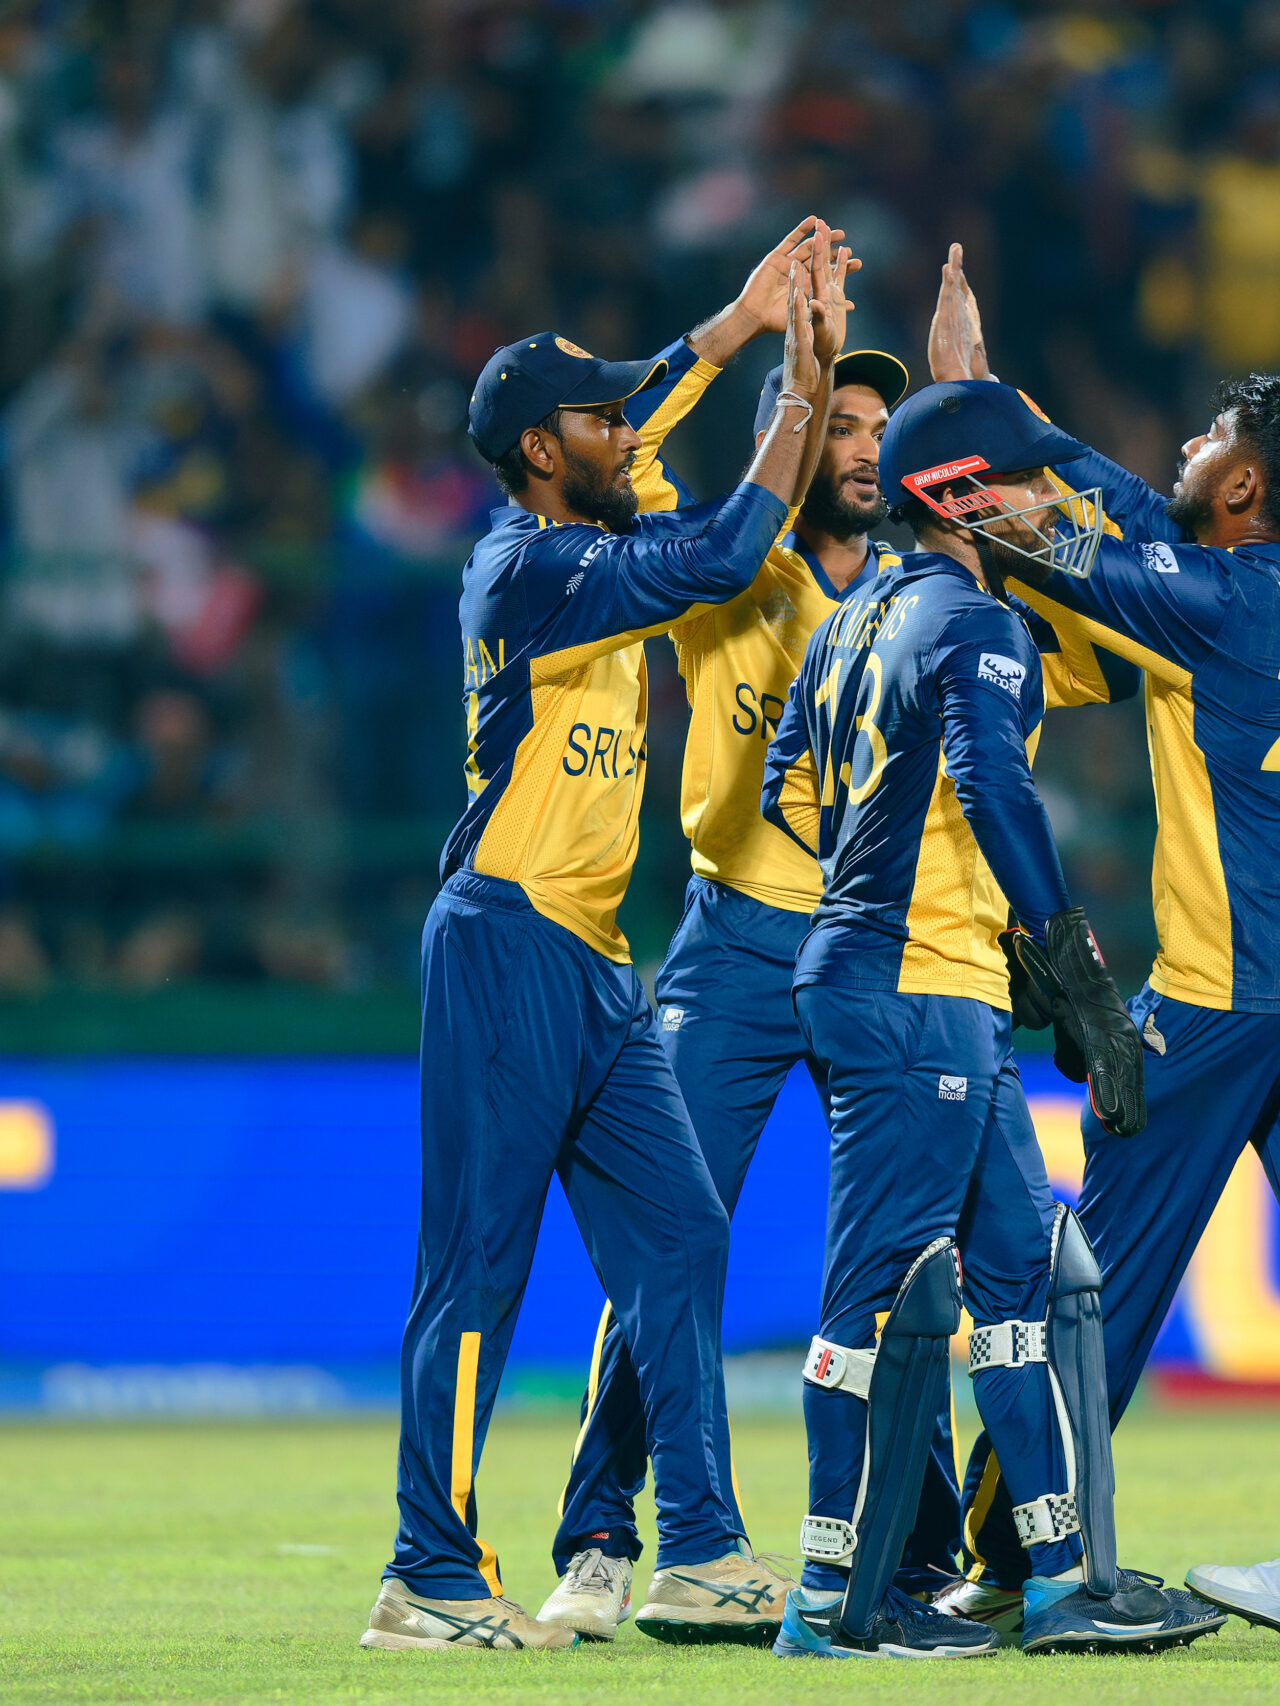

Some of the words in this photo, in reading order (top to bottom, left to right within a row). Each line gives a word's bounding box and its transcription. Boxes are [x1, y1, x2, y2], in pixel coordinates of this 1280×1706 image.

[977, 672, 1021, 699] moose
[814, 652, 888, 806] 13
[563, 722, 622, 778] SRI
[938, 1090, 966, 1102] moose
[810, 1534, 838, 1544] LEGEND
